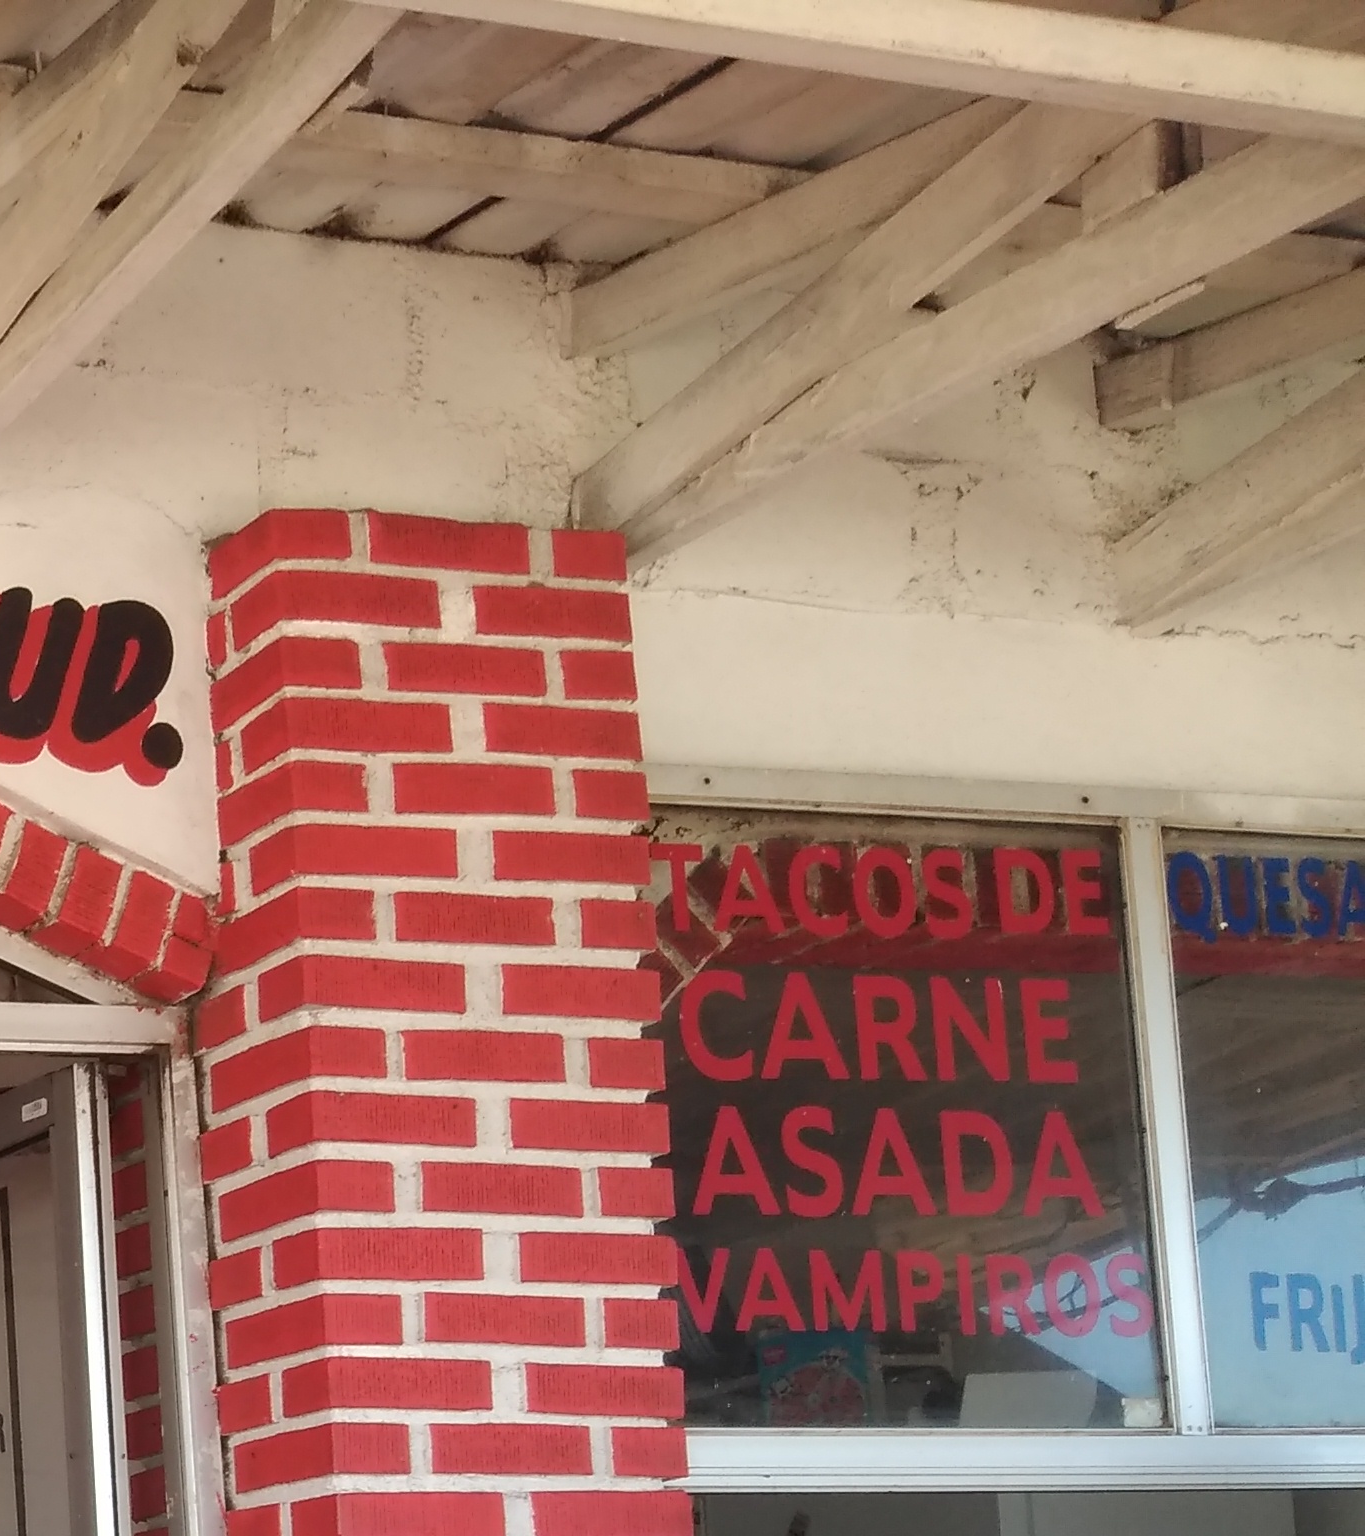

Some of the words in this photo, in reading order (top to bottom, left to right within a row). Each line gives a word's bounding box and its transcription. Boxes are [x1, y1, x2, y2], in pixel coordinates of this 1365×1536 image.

[649, 843, 967, 940] TACOS
[994, 846, 1111, 937] DE
[1168, 851, 1365, 944] QUESA
[679, 971, 1079, 1084] CARNE
[693, 1106, 1107, 1220] ASADA
[677, 1247, 1155, 1339] VAMPIROS
